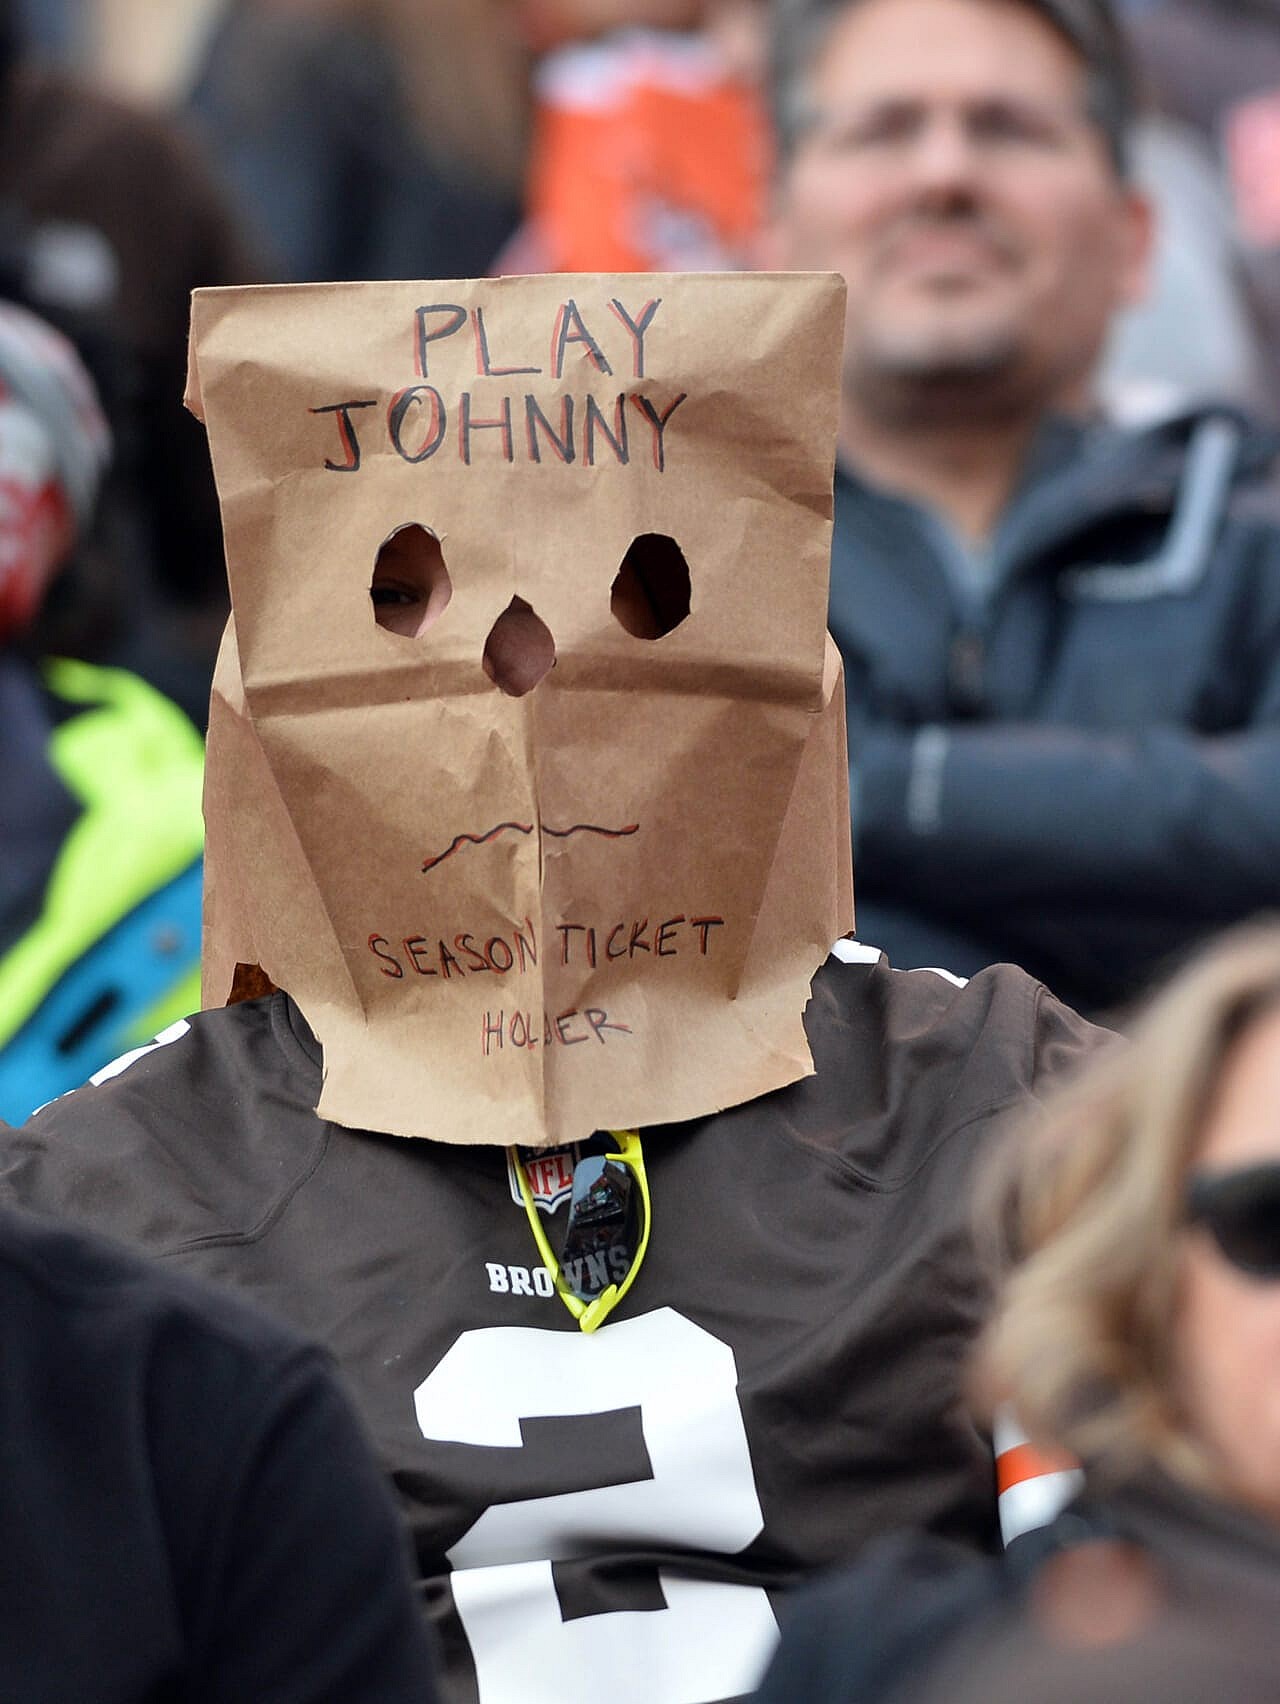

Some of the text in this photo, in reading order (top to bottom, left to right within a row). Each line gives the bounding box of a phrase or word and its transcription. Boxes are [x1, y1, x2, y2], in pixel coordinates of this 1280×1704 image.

[414, 298, 662, 378] PLAY
[309, 385, 687, 473] JOHNNY
[367, 914, 725, 979] SEASON TICKET
[525, 1156, 573, 1196] NFL
